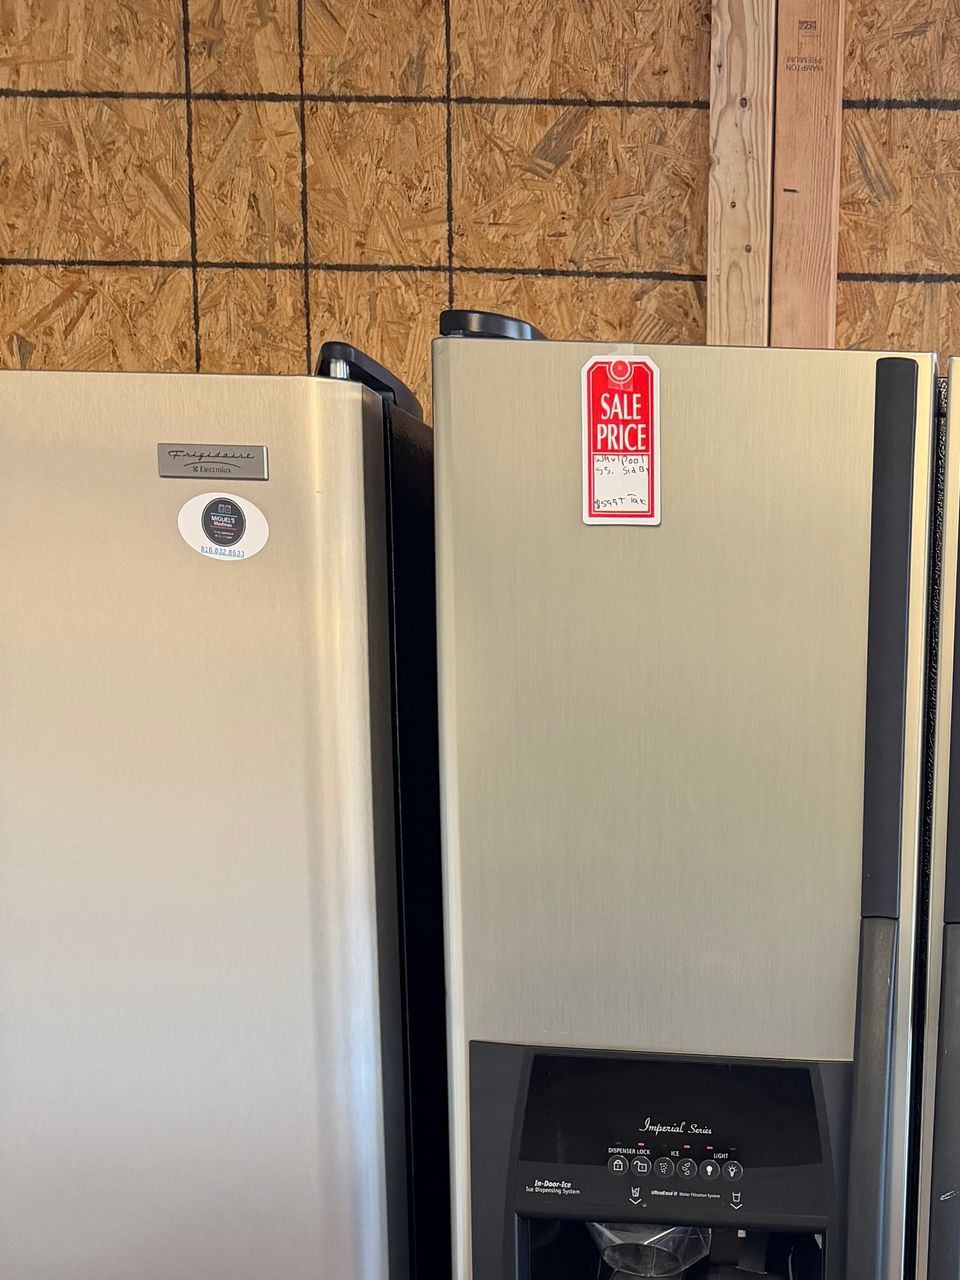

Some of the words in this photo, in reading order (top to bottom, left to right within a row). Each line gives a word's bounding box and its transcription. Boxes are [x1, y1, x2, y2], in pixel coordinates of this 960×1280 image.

[785, 63, 824, 72] HAMPTON
[601, 393, 641, 420] SALE
[597, 423, 646, 450] PRICE
[167, 450, 255, 461] Frigidaire
[200, 465, 231, 473] Electrolux
[211, 515, 236, 524] MIGUEL'S
[200, 545, 245, 558] 816.832.8633
[639, 1117, 686, 1136] Imperial
[688, 1123, 712, 1134] Series
[608, 1147, 636, 1155] DISPENSER
[534, 1179, 572, 1188] In-Door-Ice
[535, 1186, 562, 1194] Dispensing
